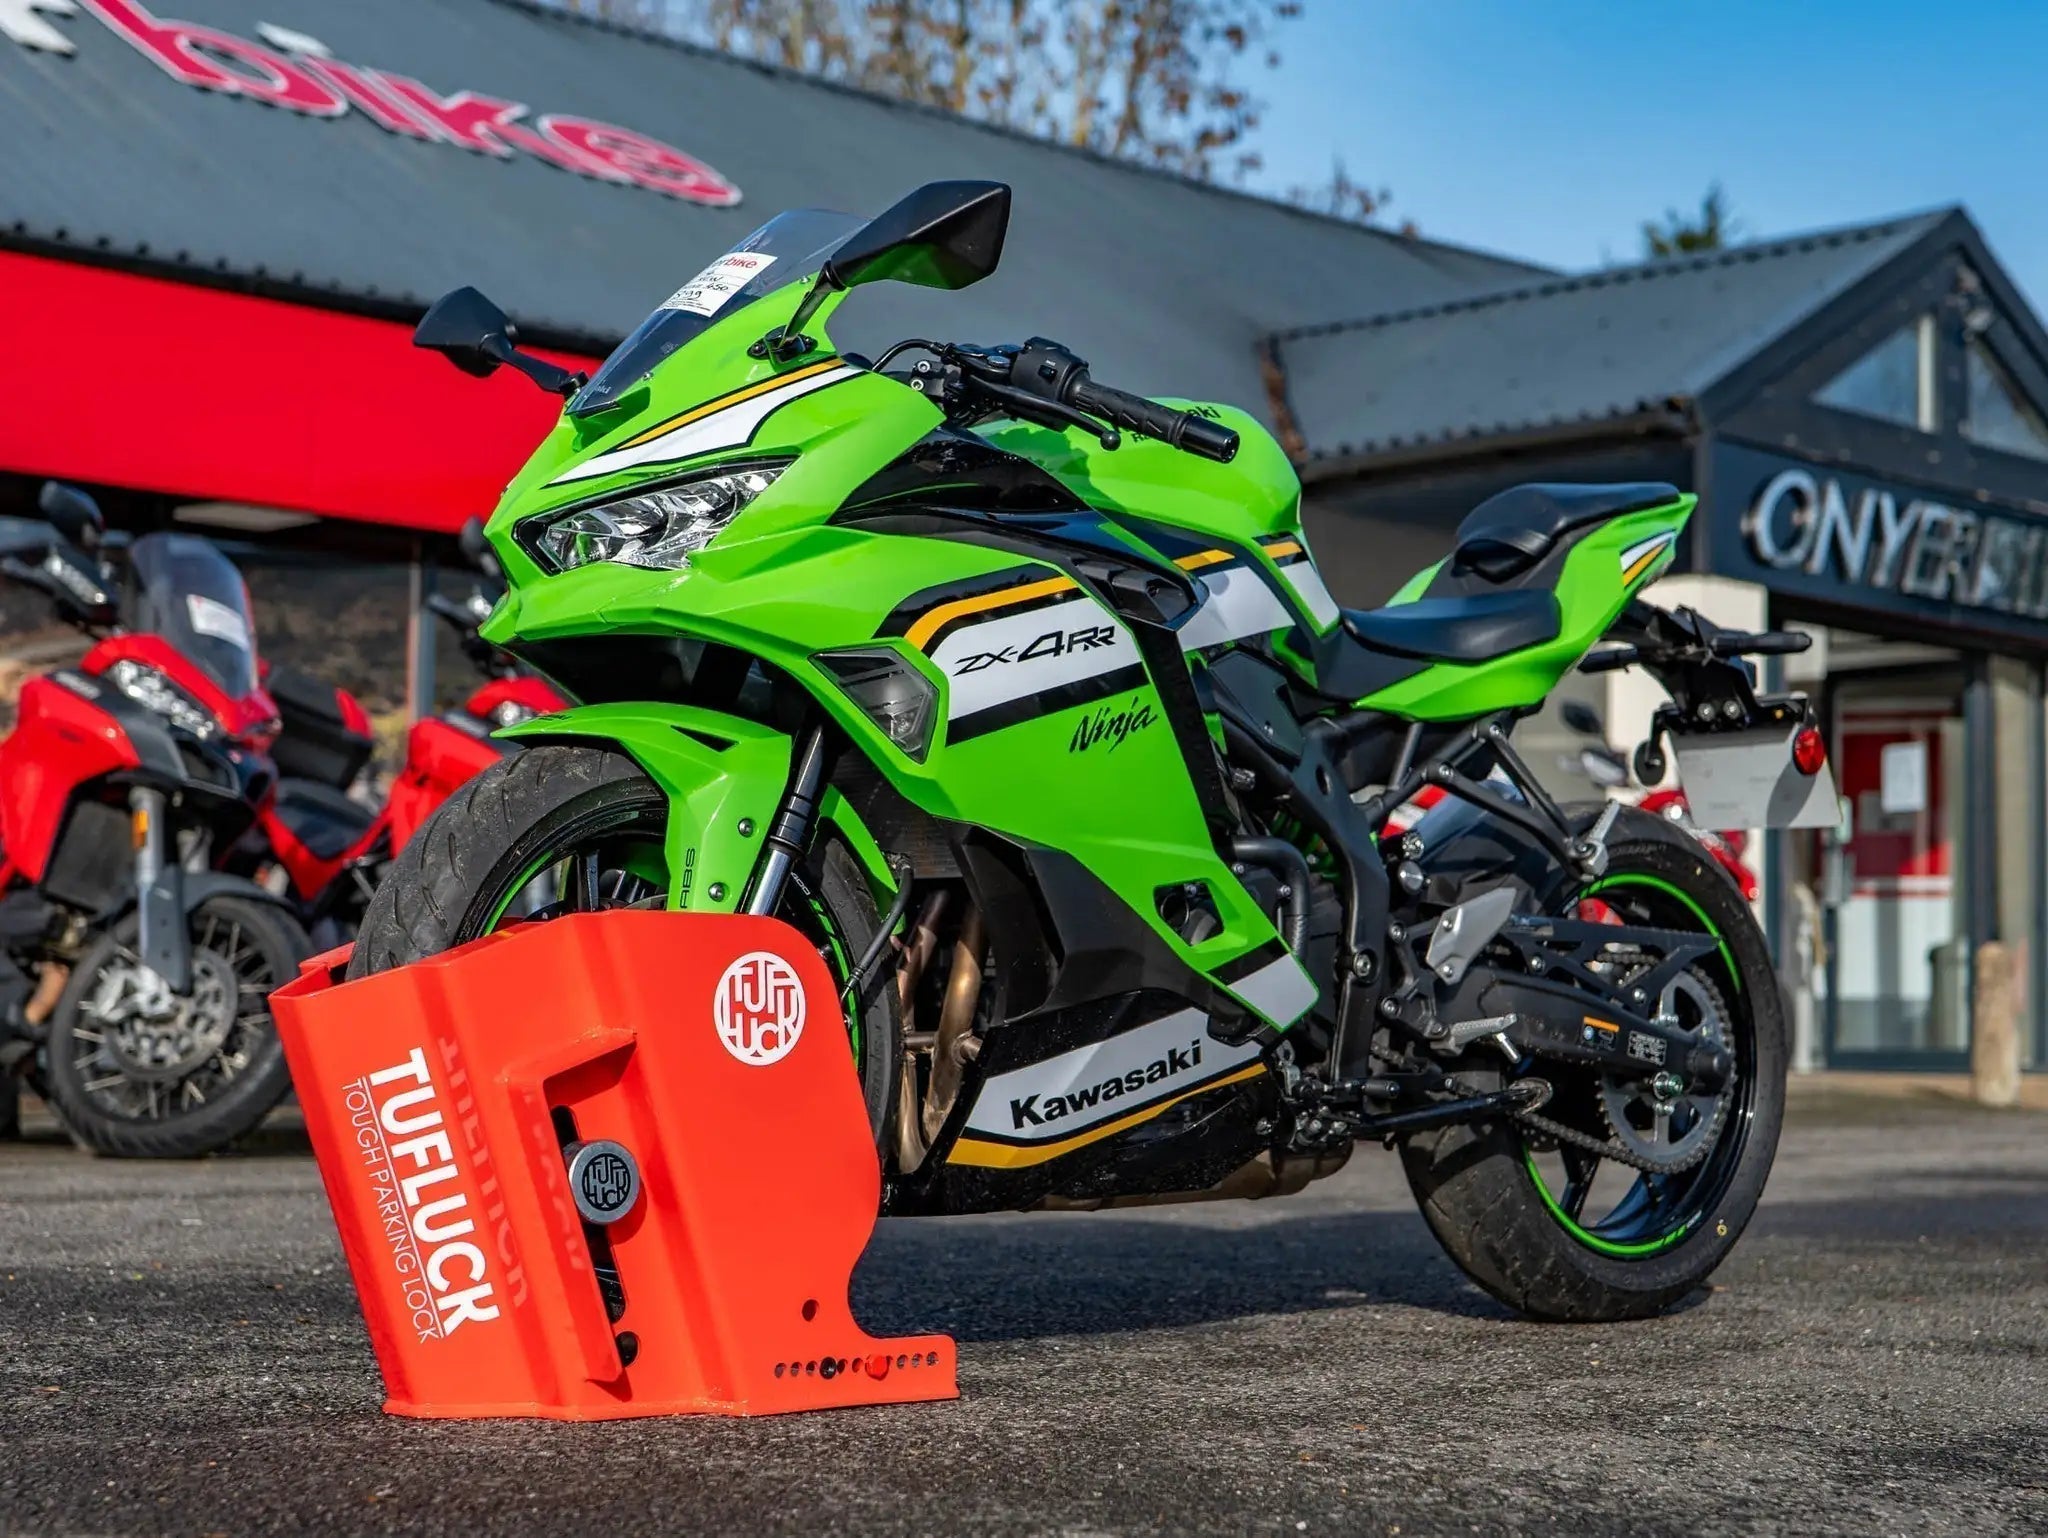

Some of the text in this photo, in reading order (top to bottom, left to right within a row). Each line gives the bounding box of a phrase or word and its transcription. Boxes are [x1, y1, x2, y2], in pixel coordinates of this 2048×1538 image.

[953, 625, 1116, 677] ZX-4RR
[1069, 696, 1158, 754] Ninja
[680, 848, 696, 909] ABS
[1010, 1039, 1202, 1129] Kawasaki
[342, 1078, 440, 1345] TOUGH PARKING LOCK
[369, 1046, 500, 1337] TUFLUCK
